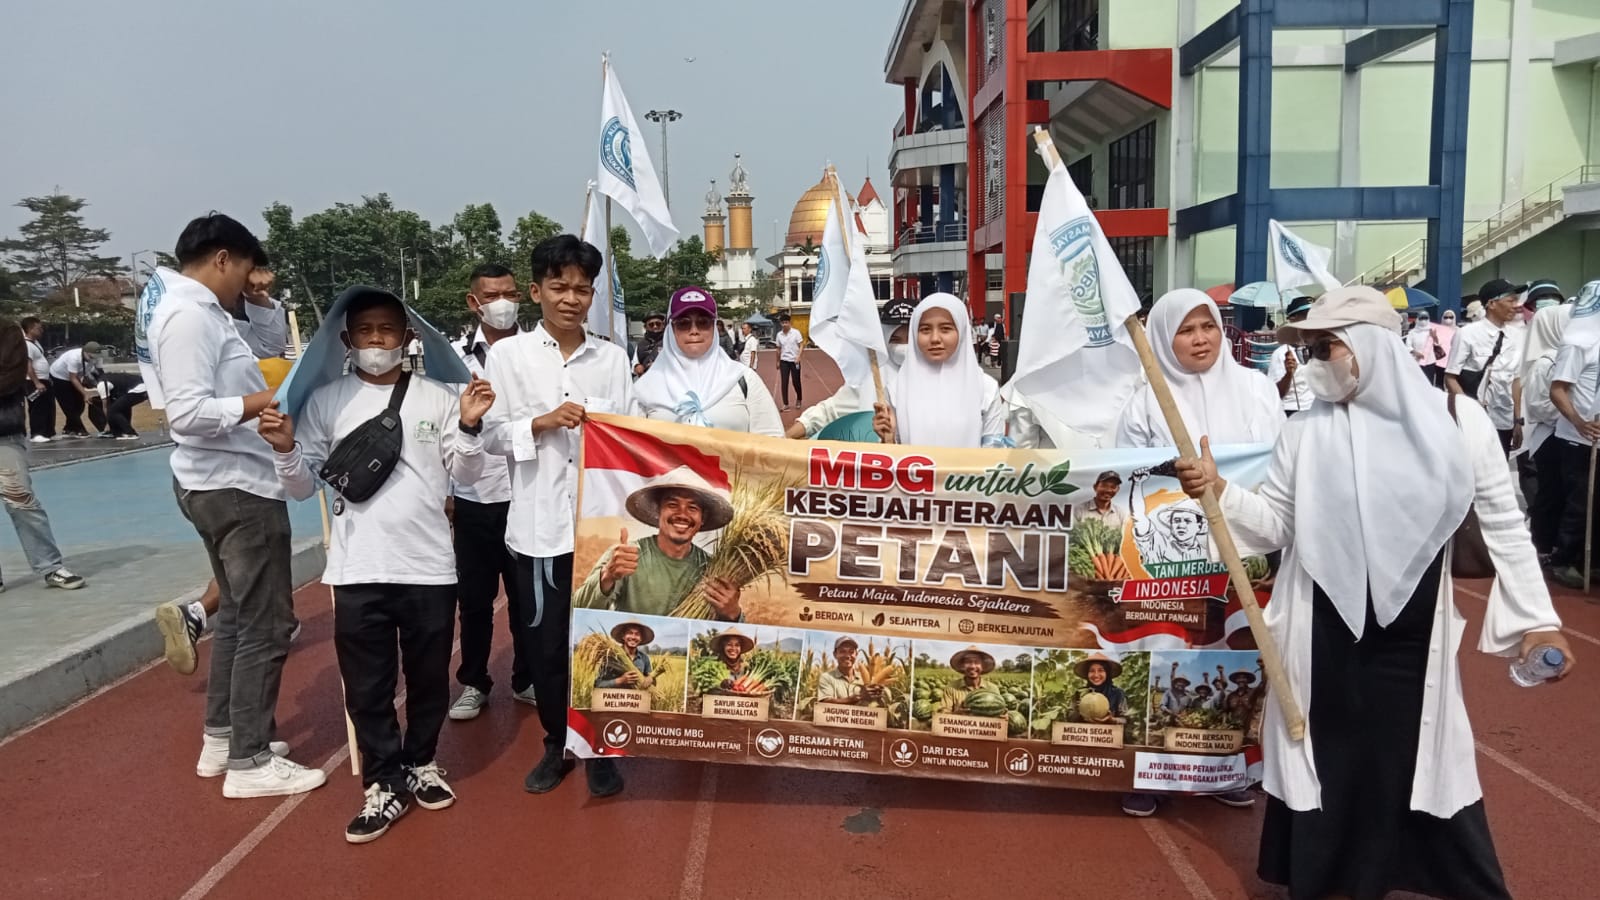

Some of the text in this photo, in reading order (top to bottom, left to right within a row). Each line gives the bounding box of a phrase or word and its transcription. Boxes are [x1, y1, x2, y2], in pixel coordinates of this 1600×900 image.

[808, 447, 1037, 498] MBG untuk
[785, 490, 1072, 529] KESEJAHTERAAN
[788, 519, 1069, 593] PETANI
[1153, 561, 1228, 578] TANI MERDEK
[1135, 579, 1211, 597] INDONESIA
[818, 586, 1031, 614] Petani Maju, Indonesia Sejahtera
[1141, 600, 1184, 611] INDONESIA
[1125, 611, 1199, 623] BERDAULAT PANGAN
[815, 610, 1054, 637] BERDAYA SEJAHTERA BERKELANJUTAN
[603, 692, 642, 701] PANEN PADI
[604, 700, 639, 709] MELIMPAH
[713, 699, 759, 709] SAYUR SEGAR
[713, 708, 758, 717] BERKUALITAS
[823, 707, 879, 718] JAGUNG BERKAH
[825, 715, 875, 726] UNTUK NEGERI
[938, 717, 1002, 729] SEMANGKA MANIS
[636, 725, 704, 738] DIDUKUNG MBG
[943, 726, 997, 737] PENUH VITAMIN
[1063, 726, 1088, 734] MELON
[789, 734, 864, 749] BERSAMA PETANI
[1061, 734, 1114, 744] BERGIZI TINGGI
[1175, 732, 1234, 742] PETANI BERSATU
[636, 736, 741, 751] UNTUK KESEJAHTERAAN PETANI
[1175, 740, 1234, 750] INDONESIA MAJU
[788, 746, 869, 760] MEMBANGUN NEGERI
[922, 745, 970, 757] DARI DESA
[922, 756, 989, 769] UNTUK INDONESIA
[1038, 754, 1125, 769] PETANI SEJAHTERA
[1148, 762, 1162, 770] AYO
[1163, 762, 1191, 771] DUKUNG
[1192, 764, 1216, 773] PETANI
[1037, 765, 1101, 777] EKONOMI MAJU
